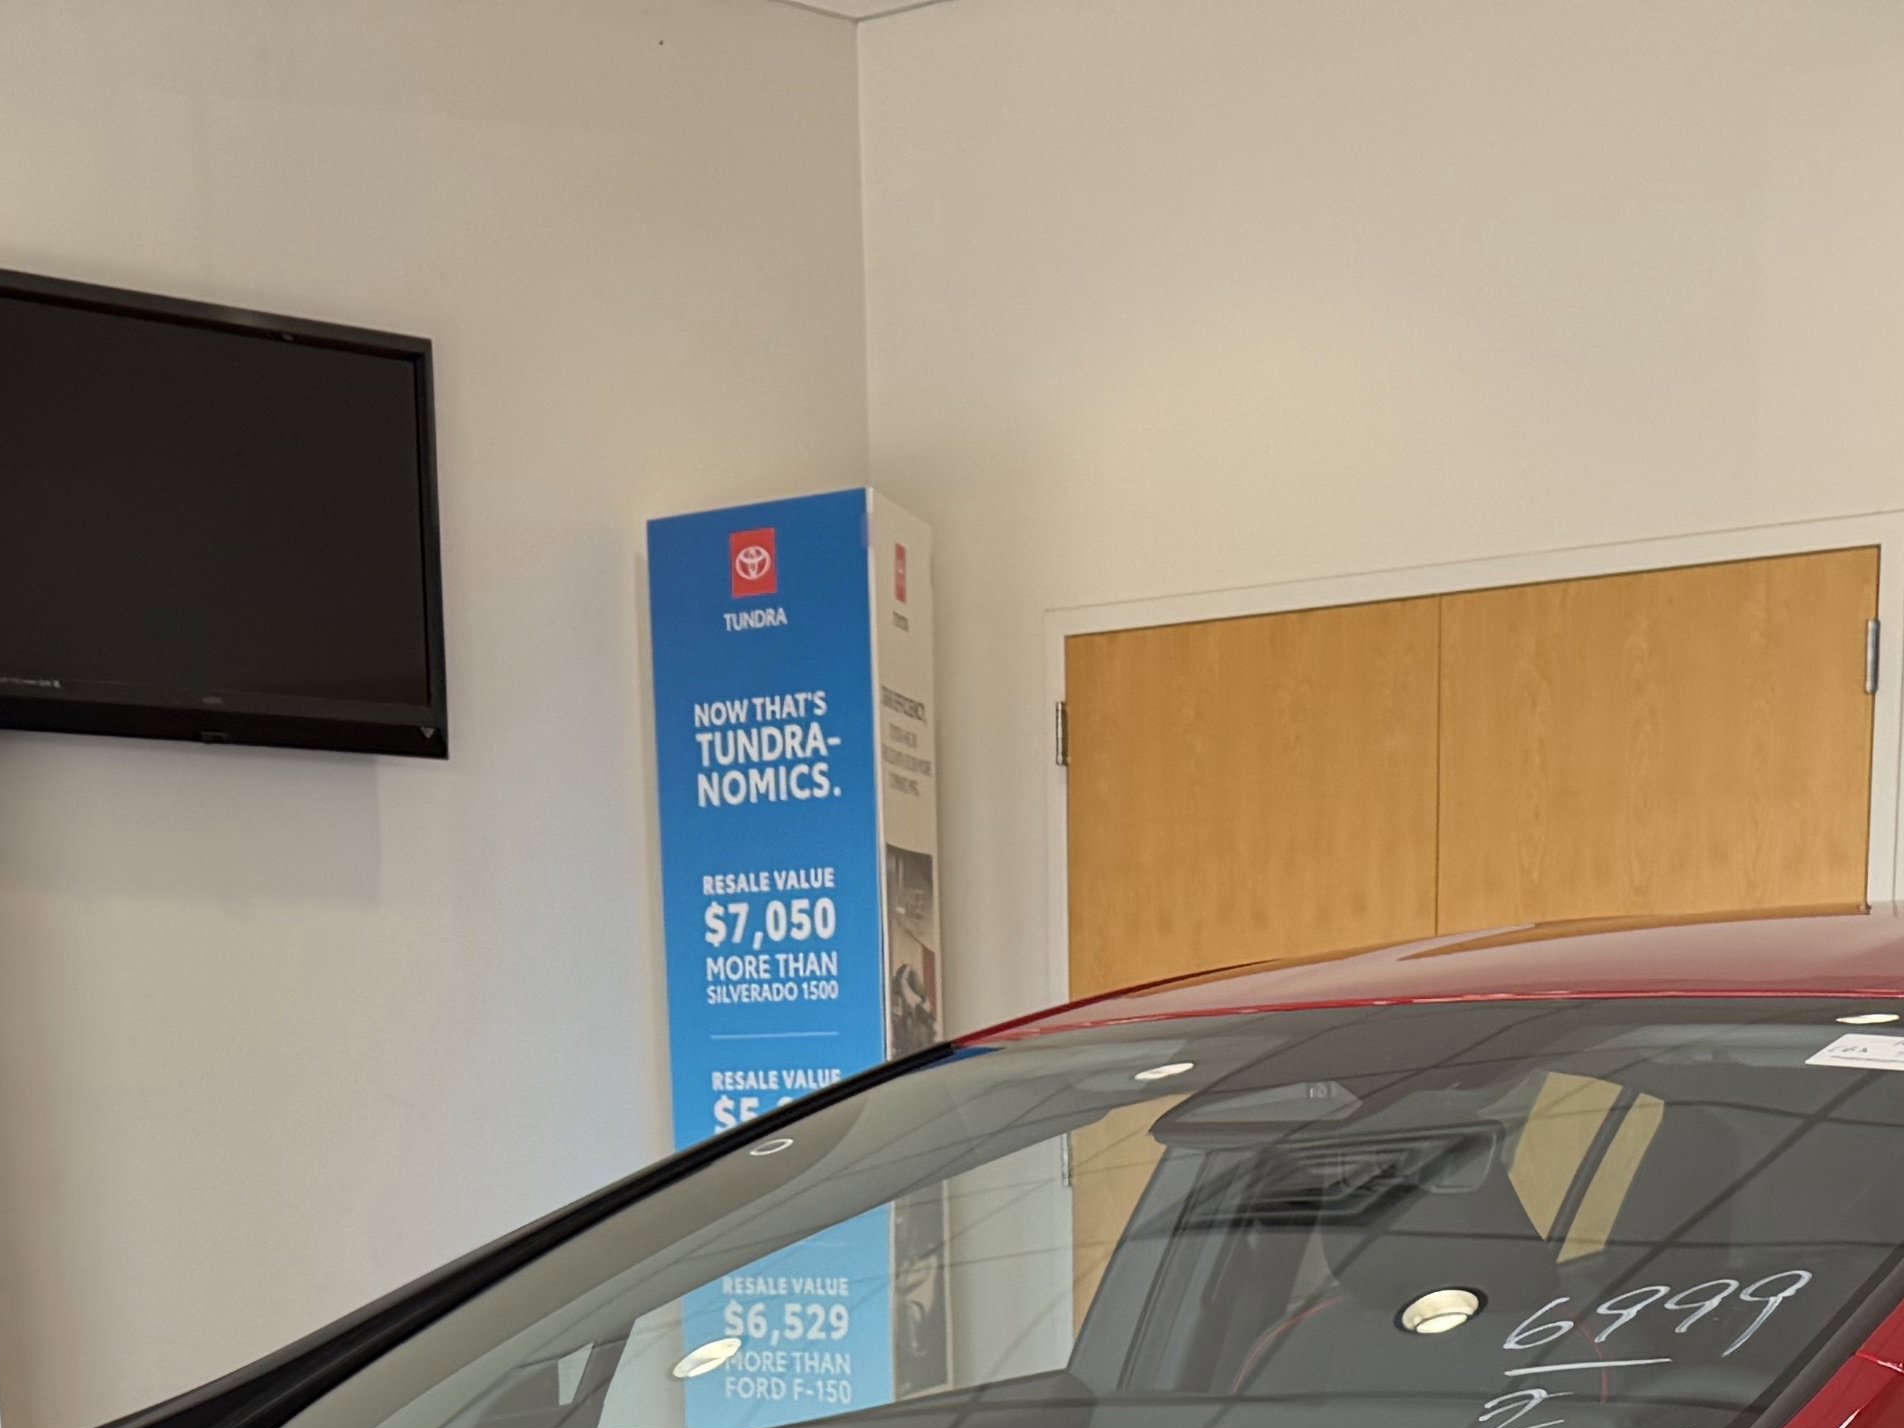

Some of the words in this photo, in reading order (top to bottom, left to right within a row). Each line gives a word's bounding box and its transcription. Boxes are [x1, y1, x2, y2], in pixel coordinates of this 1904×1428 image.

[723, 608, 788, 632] TUNDRA
[694, 699, 748, 728] NOW
[751, 690, 828, 722] THAT'S
[695, 722, 841, 767] TUNDRA-
[697, 762, 842, 808] NOMICS.
[703, 871, 770, 896] RESALE
[773, 867, 836, 891] VALUE
[704, 897, 837, 951] $7,050
[707, 953, 771, 982] MORE
[775, 950, 838, 978] THAN
[707, 982, 799, 1006] SILVERADO
[803, 979, 839, 1001] 1500
[712, 1070, 780, 1091] RESALE
[782, 1068, 842, 1089] VALUE
[721, 1275, 787, 1296] RESALE
[790, 1277, 850, 1297] VALUE
[723, 1300, 850, 1348] $6,529
[1503, 1268, 1813, 1357] 6999
[724, 1351, 789, 1375] MORE
[792, 1351, 852, 1376] THAN
[725, 1375, 788, 1402] FORD
[793, 1378, 853, 1405] F-150
